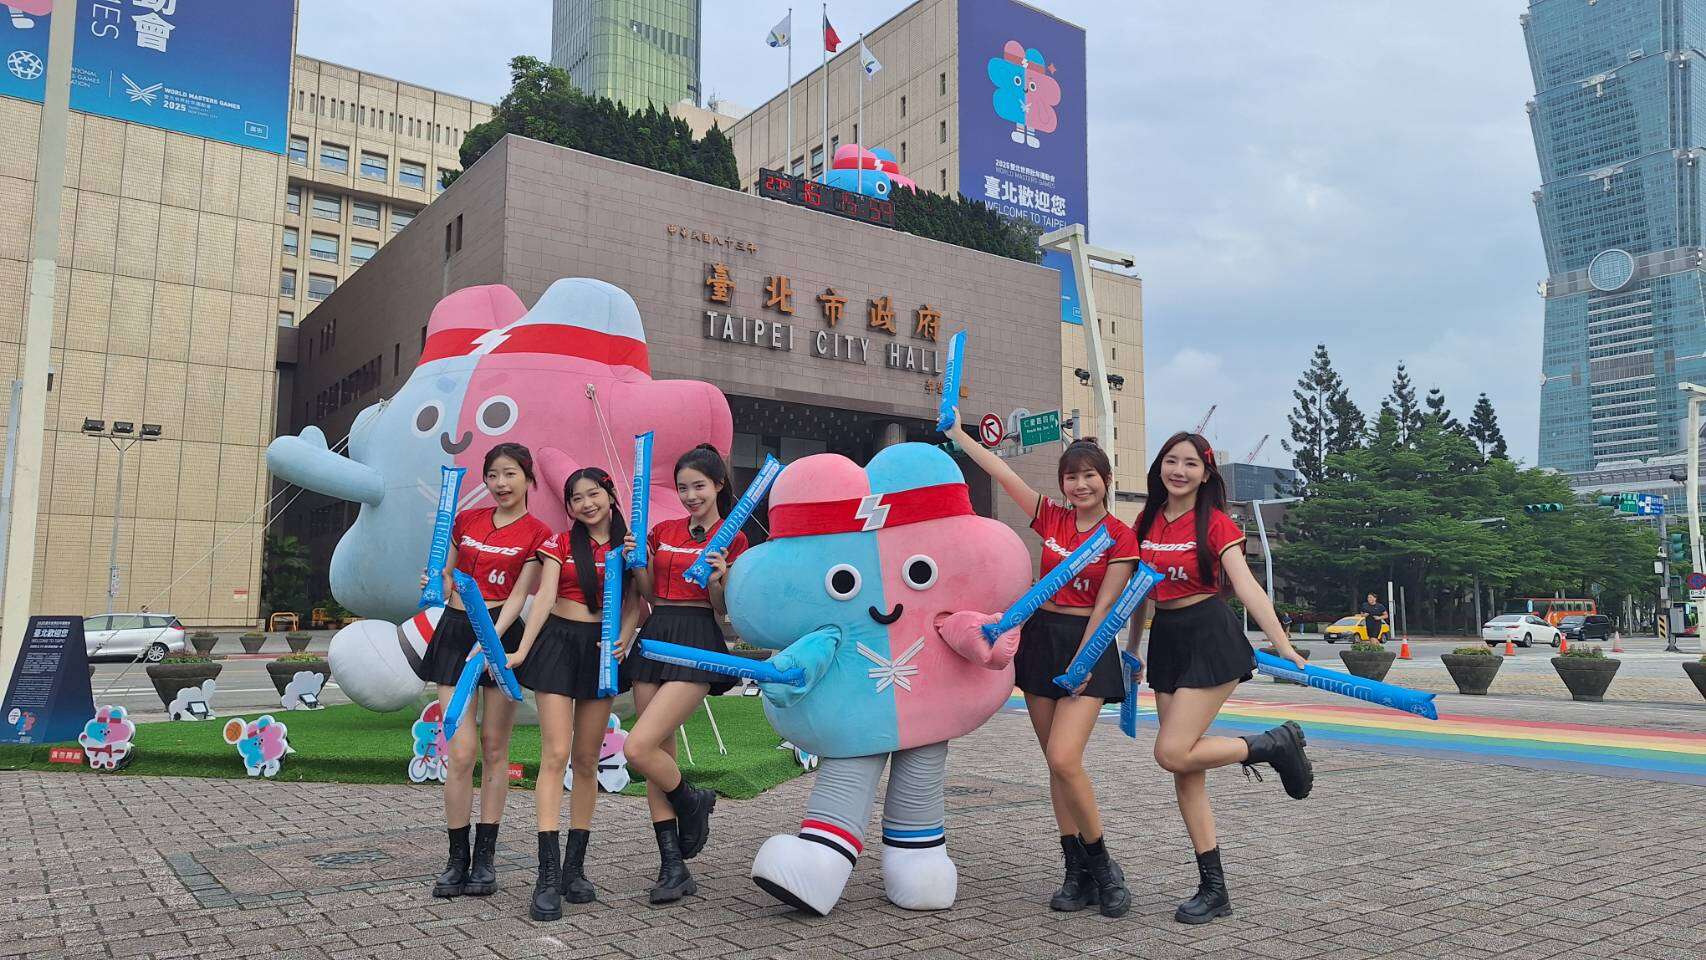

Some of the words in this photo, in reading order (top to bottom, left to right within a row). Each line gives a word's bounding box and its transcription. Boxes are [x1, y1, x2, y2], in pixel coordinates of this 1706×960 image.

[91, 0, 121, 39] ES
[163, 100, 186, 111] 2025
[164, 87, 187, 97] WORLD
[189, 93, 218, 104] MASTERS
[219, 100, 240, 110] GAMES
[984, 175, 1066, 216] 臺北歡迎您
[985, 200, 1028, 219] WELCOME
[1030, 211, 1041, 224] TO
[1042, 215, 1067, 229] TAIPEI
[706, 261, 943, 343] 臺北市政府
[707, 311, 794, 350] TAIPEI
[816, 329, 870, 362] CITY
[890, 343, 943, 374] HALL
[488, 569, 505, 585] 66
[1073, 577, 1090, 592] 41
[1167, 566, 1188, 581] 24
